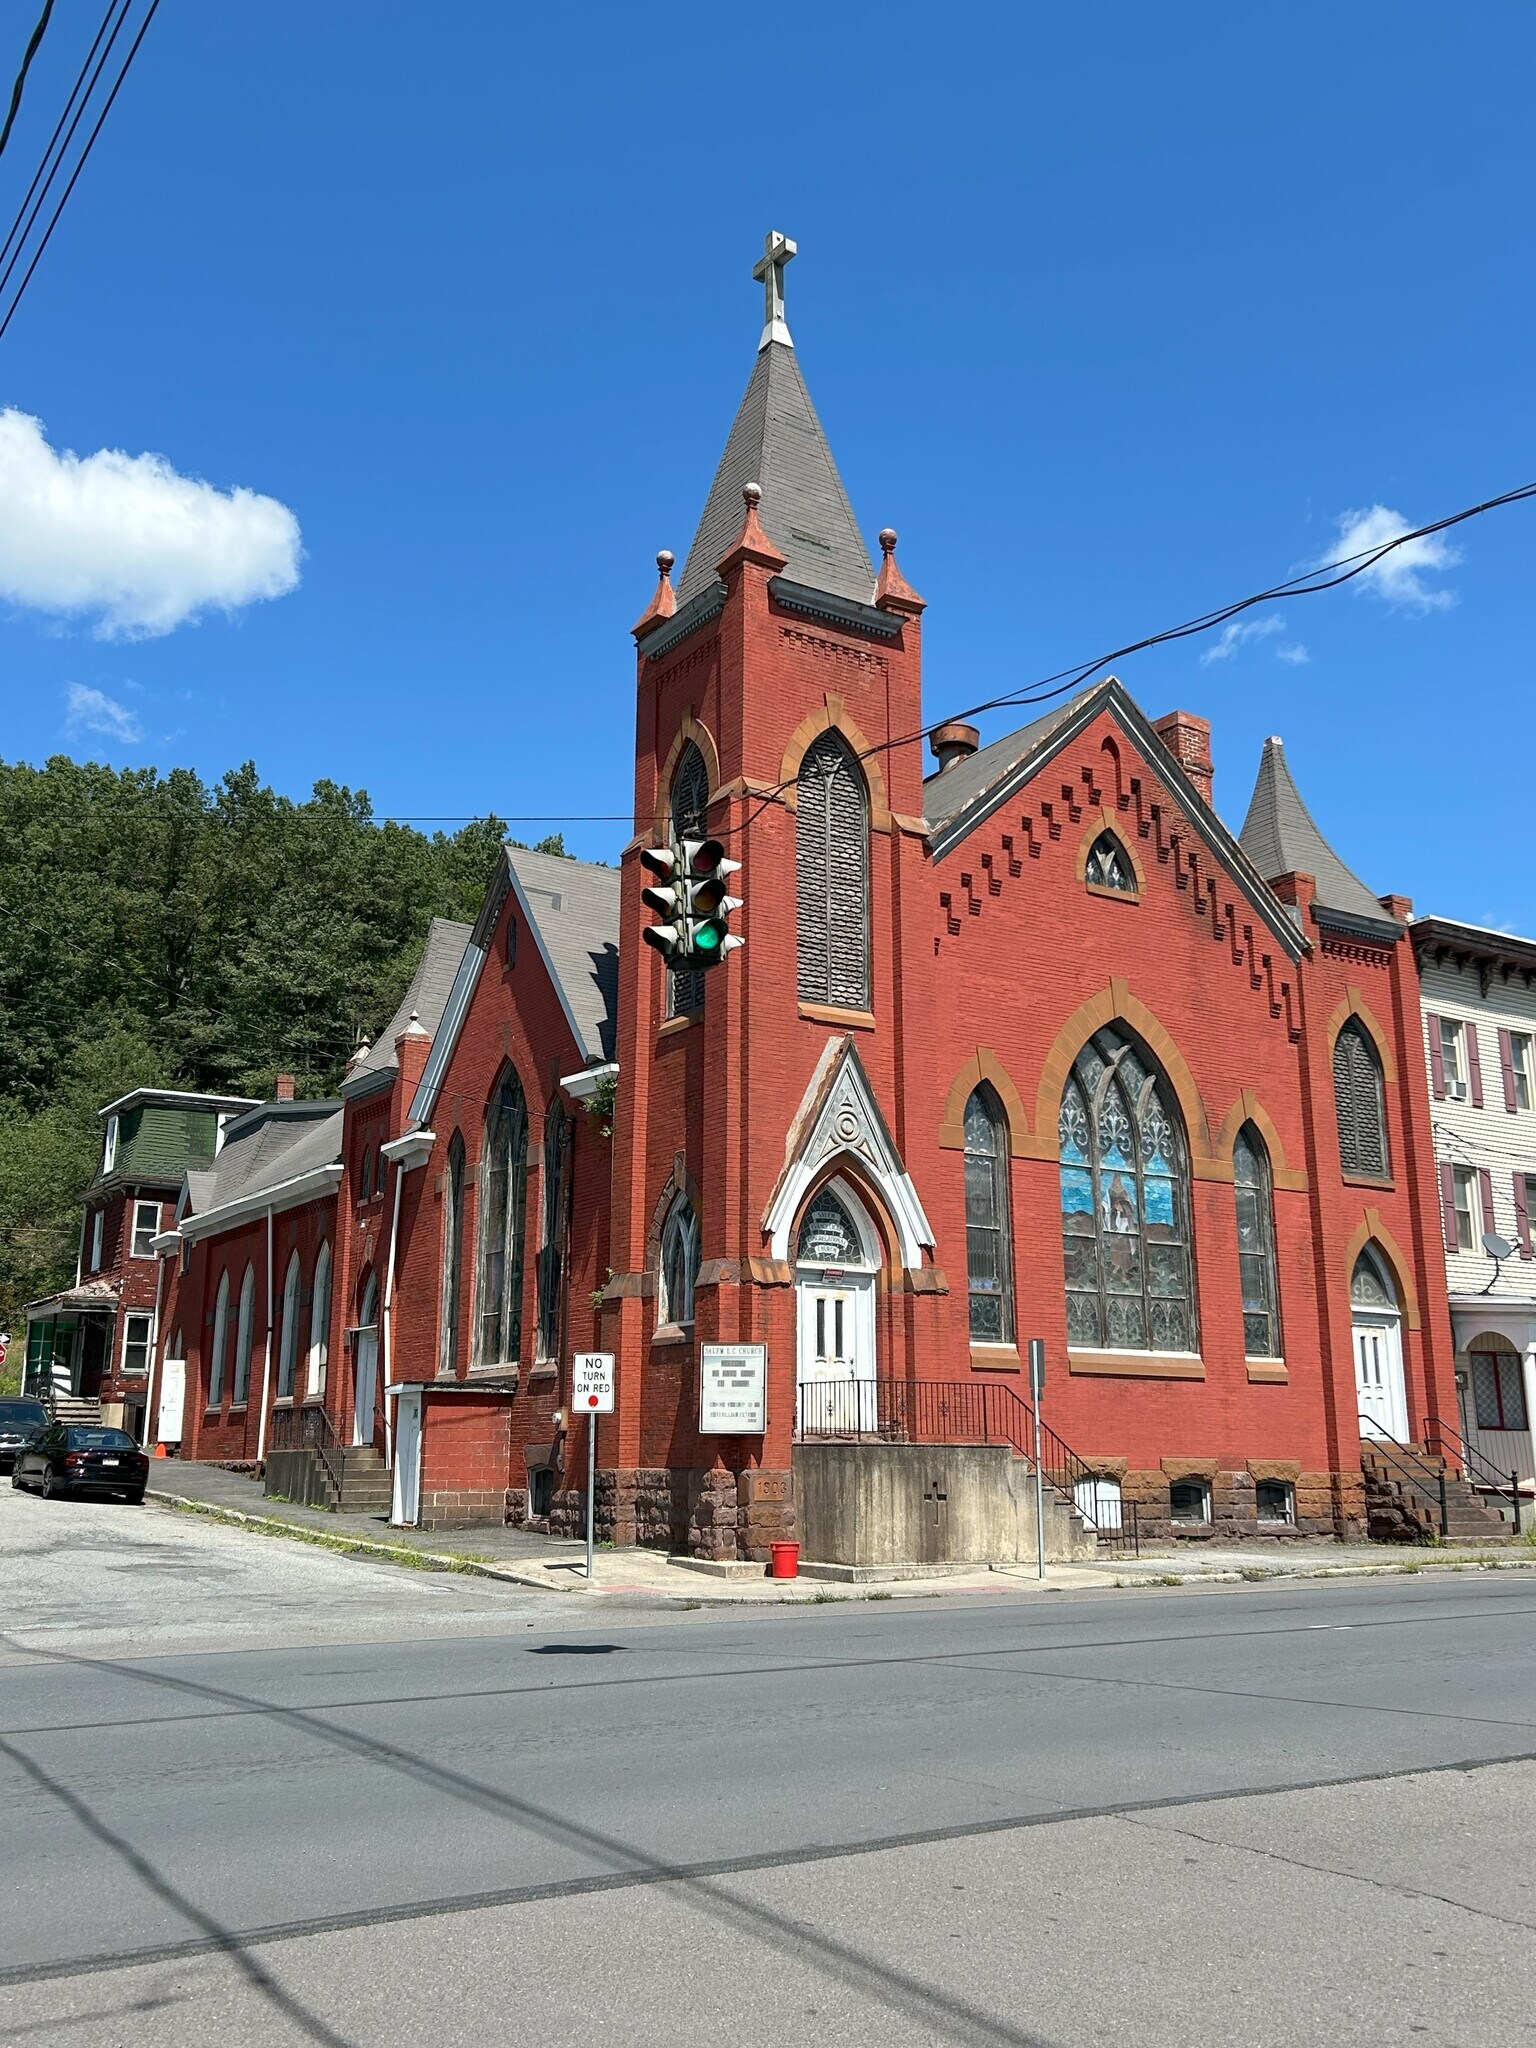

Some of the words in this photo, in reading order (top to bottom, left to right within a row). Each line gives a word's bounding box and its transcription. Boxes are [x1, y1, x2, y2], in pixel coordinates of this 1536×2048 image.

[586, 1358, 602, 1368] NO
[583, 1372, 605, 1380] TURN
[577, 1384, 589, 1392] ON
[593, 1384, 610, 1392] RED
